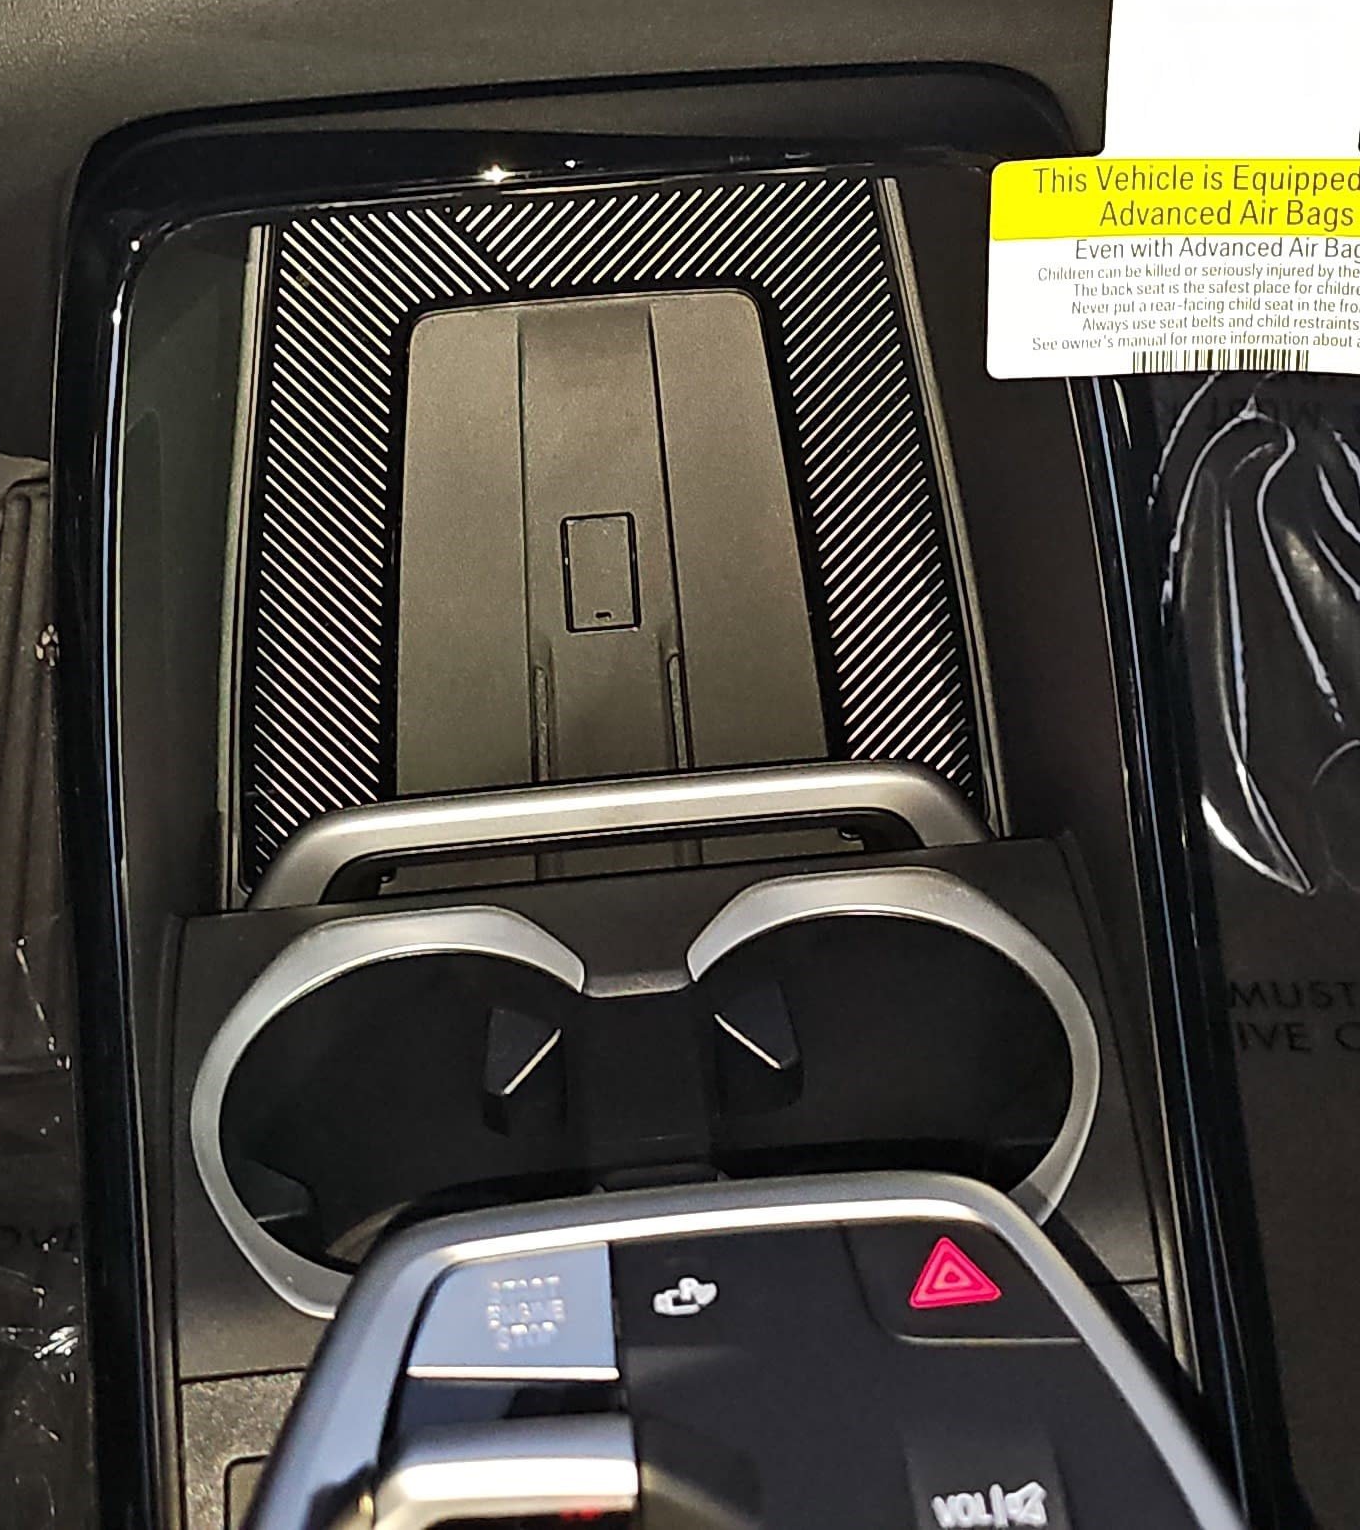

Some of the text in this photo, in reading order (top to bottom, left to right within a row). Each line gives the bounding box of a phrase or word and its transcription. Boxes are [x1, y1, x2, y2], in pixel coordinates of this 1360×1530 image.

[1033, 167, 1088, 194] This
[1096, 164, 1194, 191] Vehicle
[1204, 164, 1223, 190] is
[1099, 200, 1354, 232] Advanced Air Bags
[1075, 239, 1124, 260] Even
[1131, 237, 1173, 258] with
[1179, 237, 1283, 258] Advanced
[1289, 237, 1319, 258] Air
[1038, 267, 1094, 282] Children
[1097, 268, 1121, 279] can
[1125, 265, 1142, 278] be
[1145, 264, 1181, 278] killed
[1184, 266, 1197, 277] or
[1201, 263, 1263, 279] seriously
[1266, 264, 1314, 280] injured
[1318, 265, 1334, 281] by
[1338, 265, 1360, 279] the
[1074, 283, 1098, 297] The
[1102, 282, 1133, 296] back
[1136, 282, 1165, 295] seat
[1168, 282, 1180, 295] is
[1183, 281, 1205, 294] the
[1208, 280, 1250, 295] safest
[1253, 281, 1291, 296] place
[1294, 281, 1313, 294] for
[1071, 301, 1109, 315] Never
[1114, 301, 1135, 316] put
[1138, 302, 1147, 313] a
[1150, 298, 1225, 314] rear-facing
[1228, 298, 1261, 312] child
[1264, 299, 1294, 312] seat
[1298, 298, 1310, 312] in
[1313, 299, 1336, 313] the
[1082, 318, 1129, 334] Always
[1132, 319, 1156, 330] use
[1159, 317, 1188, 330] seat
[1191, 315, 1225, 329] belts
[1228, 314, 1253, 328] and
[1256, 314, 1290, 328] child
[1032, 336, 1058, 351] See
[1061, 335, 1114, 350] owner's
[1117, 333, 1167, 348] manual
[1170, 332, 1188, 346] for
[1191, 333, 1227, 345] more
[1230, 331, 1309, 347] information
[1312, 333, 1353, 348] about
[1229, 980, 1357, 1010] MUST
